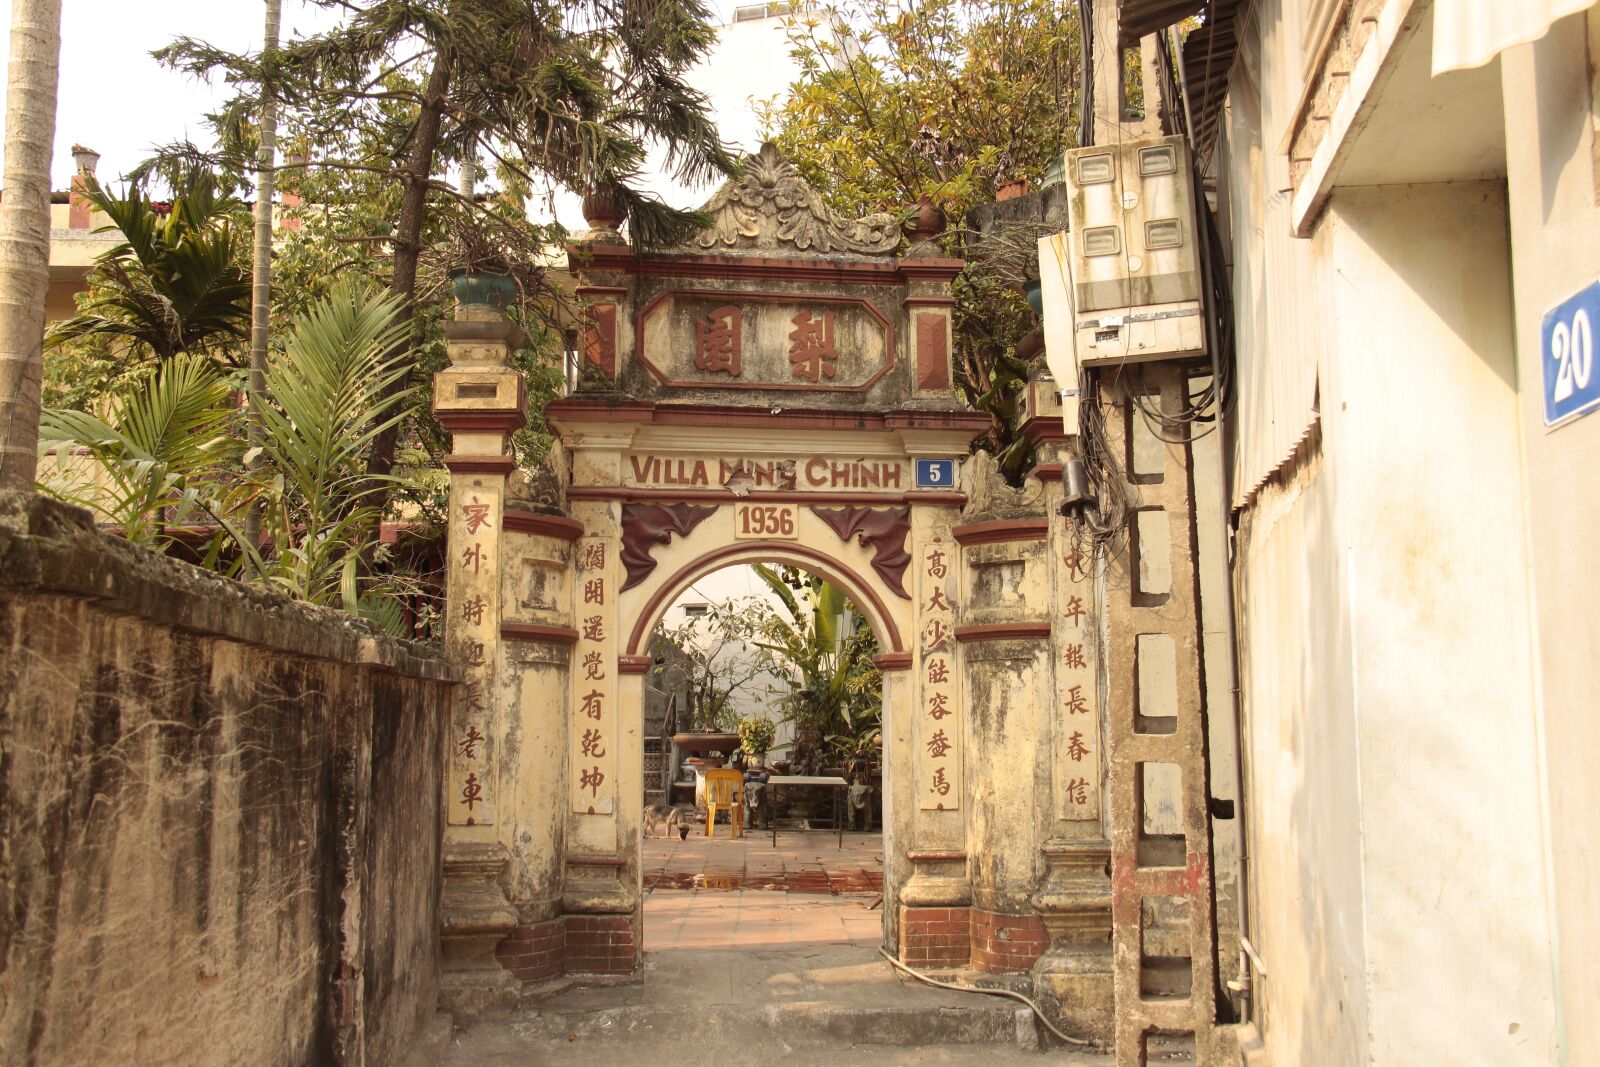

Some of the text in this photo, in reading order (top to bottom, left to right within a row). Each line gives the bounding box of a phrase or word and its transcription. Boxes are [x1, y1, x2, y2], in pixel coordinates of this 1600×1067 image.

[1551, 308, 1593, 404] 20
[629, 455, 709, 486] VILLA
[805, 457, 901, 488] CHÍNH
[928, 463, 942, 483] 5
[738, 506, 794, 535] 1936
[1063, 516, 1091, 805] 中年報長春信
